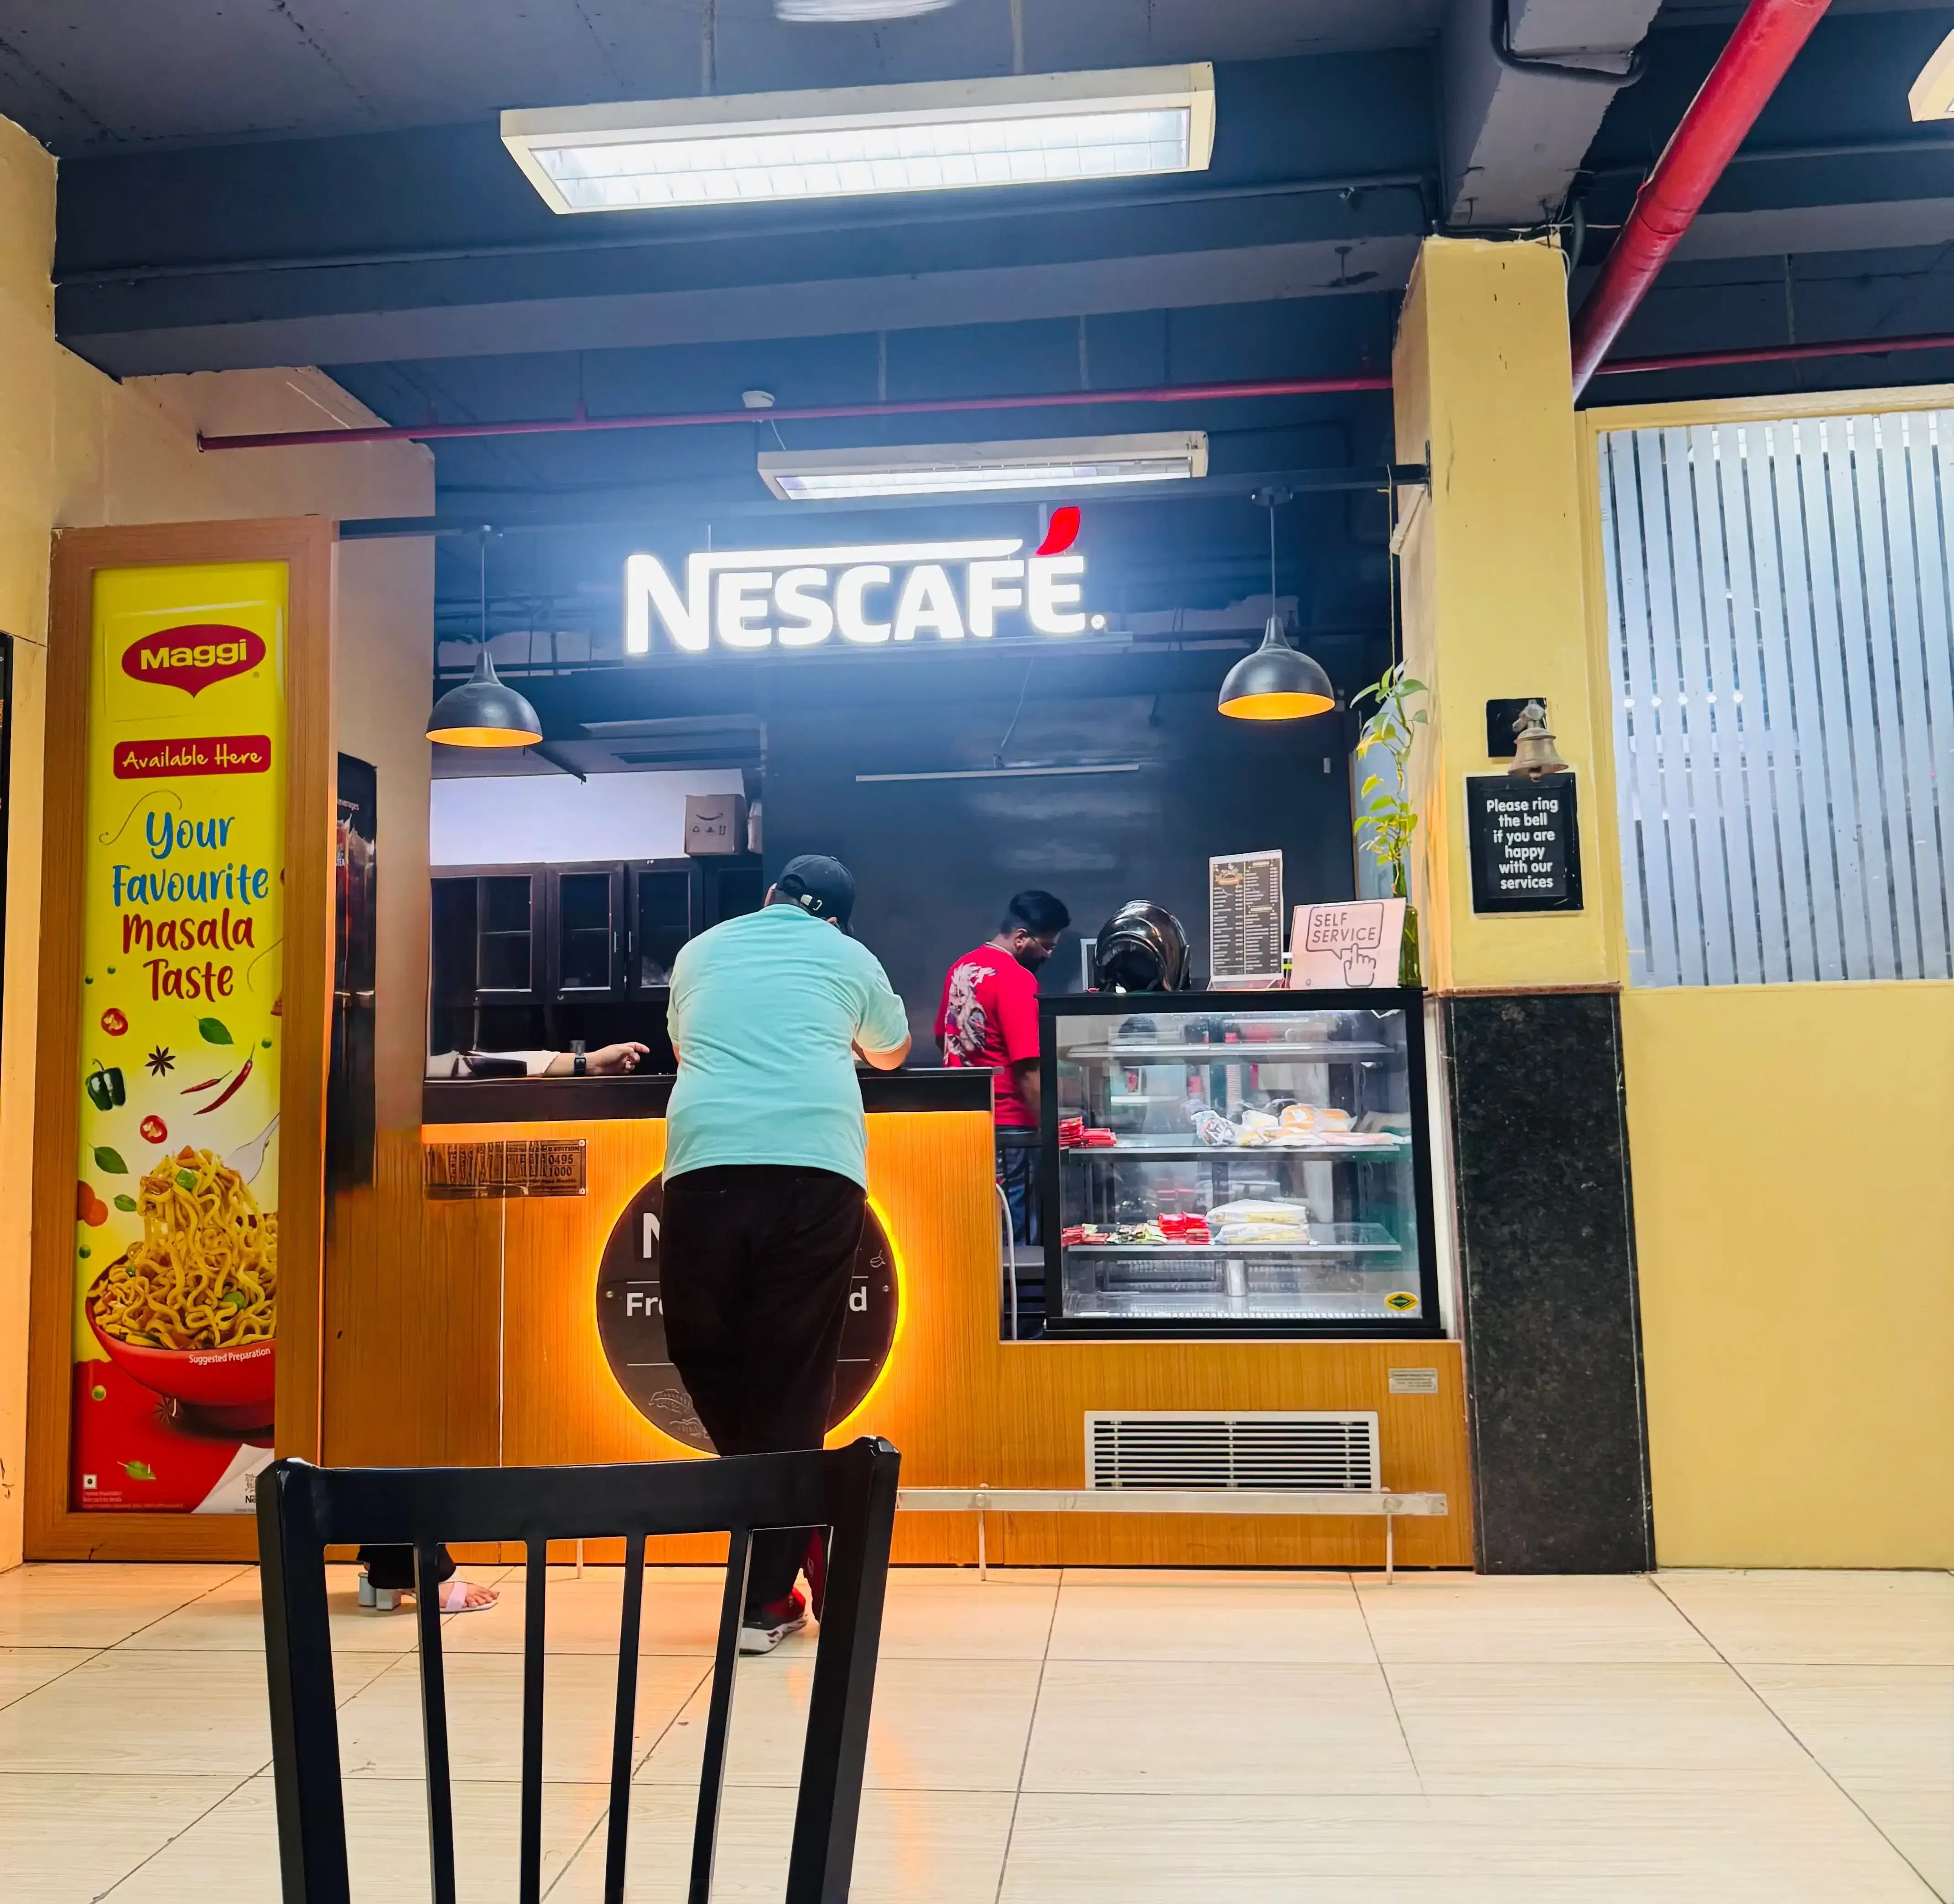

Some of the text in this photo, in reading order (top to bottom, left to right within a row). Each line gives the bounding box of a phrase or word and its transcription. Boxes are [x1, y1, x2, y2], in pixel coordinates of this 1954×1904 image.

[140, 638, 247, 670] Maggi
[122, 743, 262, 769] Available Here
[1486, 797, 1558, 813] Please ring
[1498, 812, 1548, 827] the bell
[146, 812, 235, 860] Your
[1493, 829, 1555, 846] if you are
[1505, 845, 1545, 861] happy
[1498, 860, 1553, 874] with our
[113, 862, 269, 907] Favourite
[1500, 875, 1554, 889] services
[1314, 912, 1347, 927] SELF
[1312, 927, 1376, 943] SERVICE
[143, 958, 234, 1003] Taste
[548, 1154, 573, 1165] 0495
[549, 1166, 572, 1177] 1000
[189, 1348, 270, 1365] Suggested Preparation
